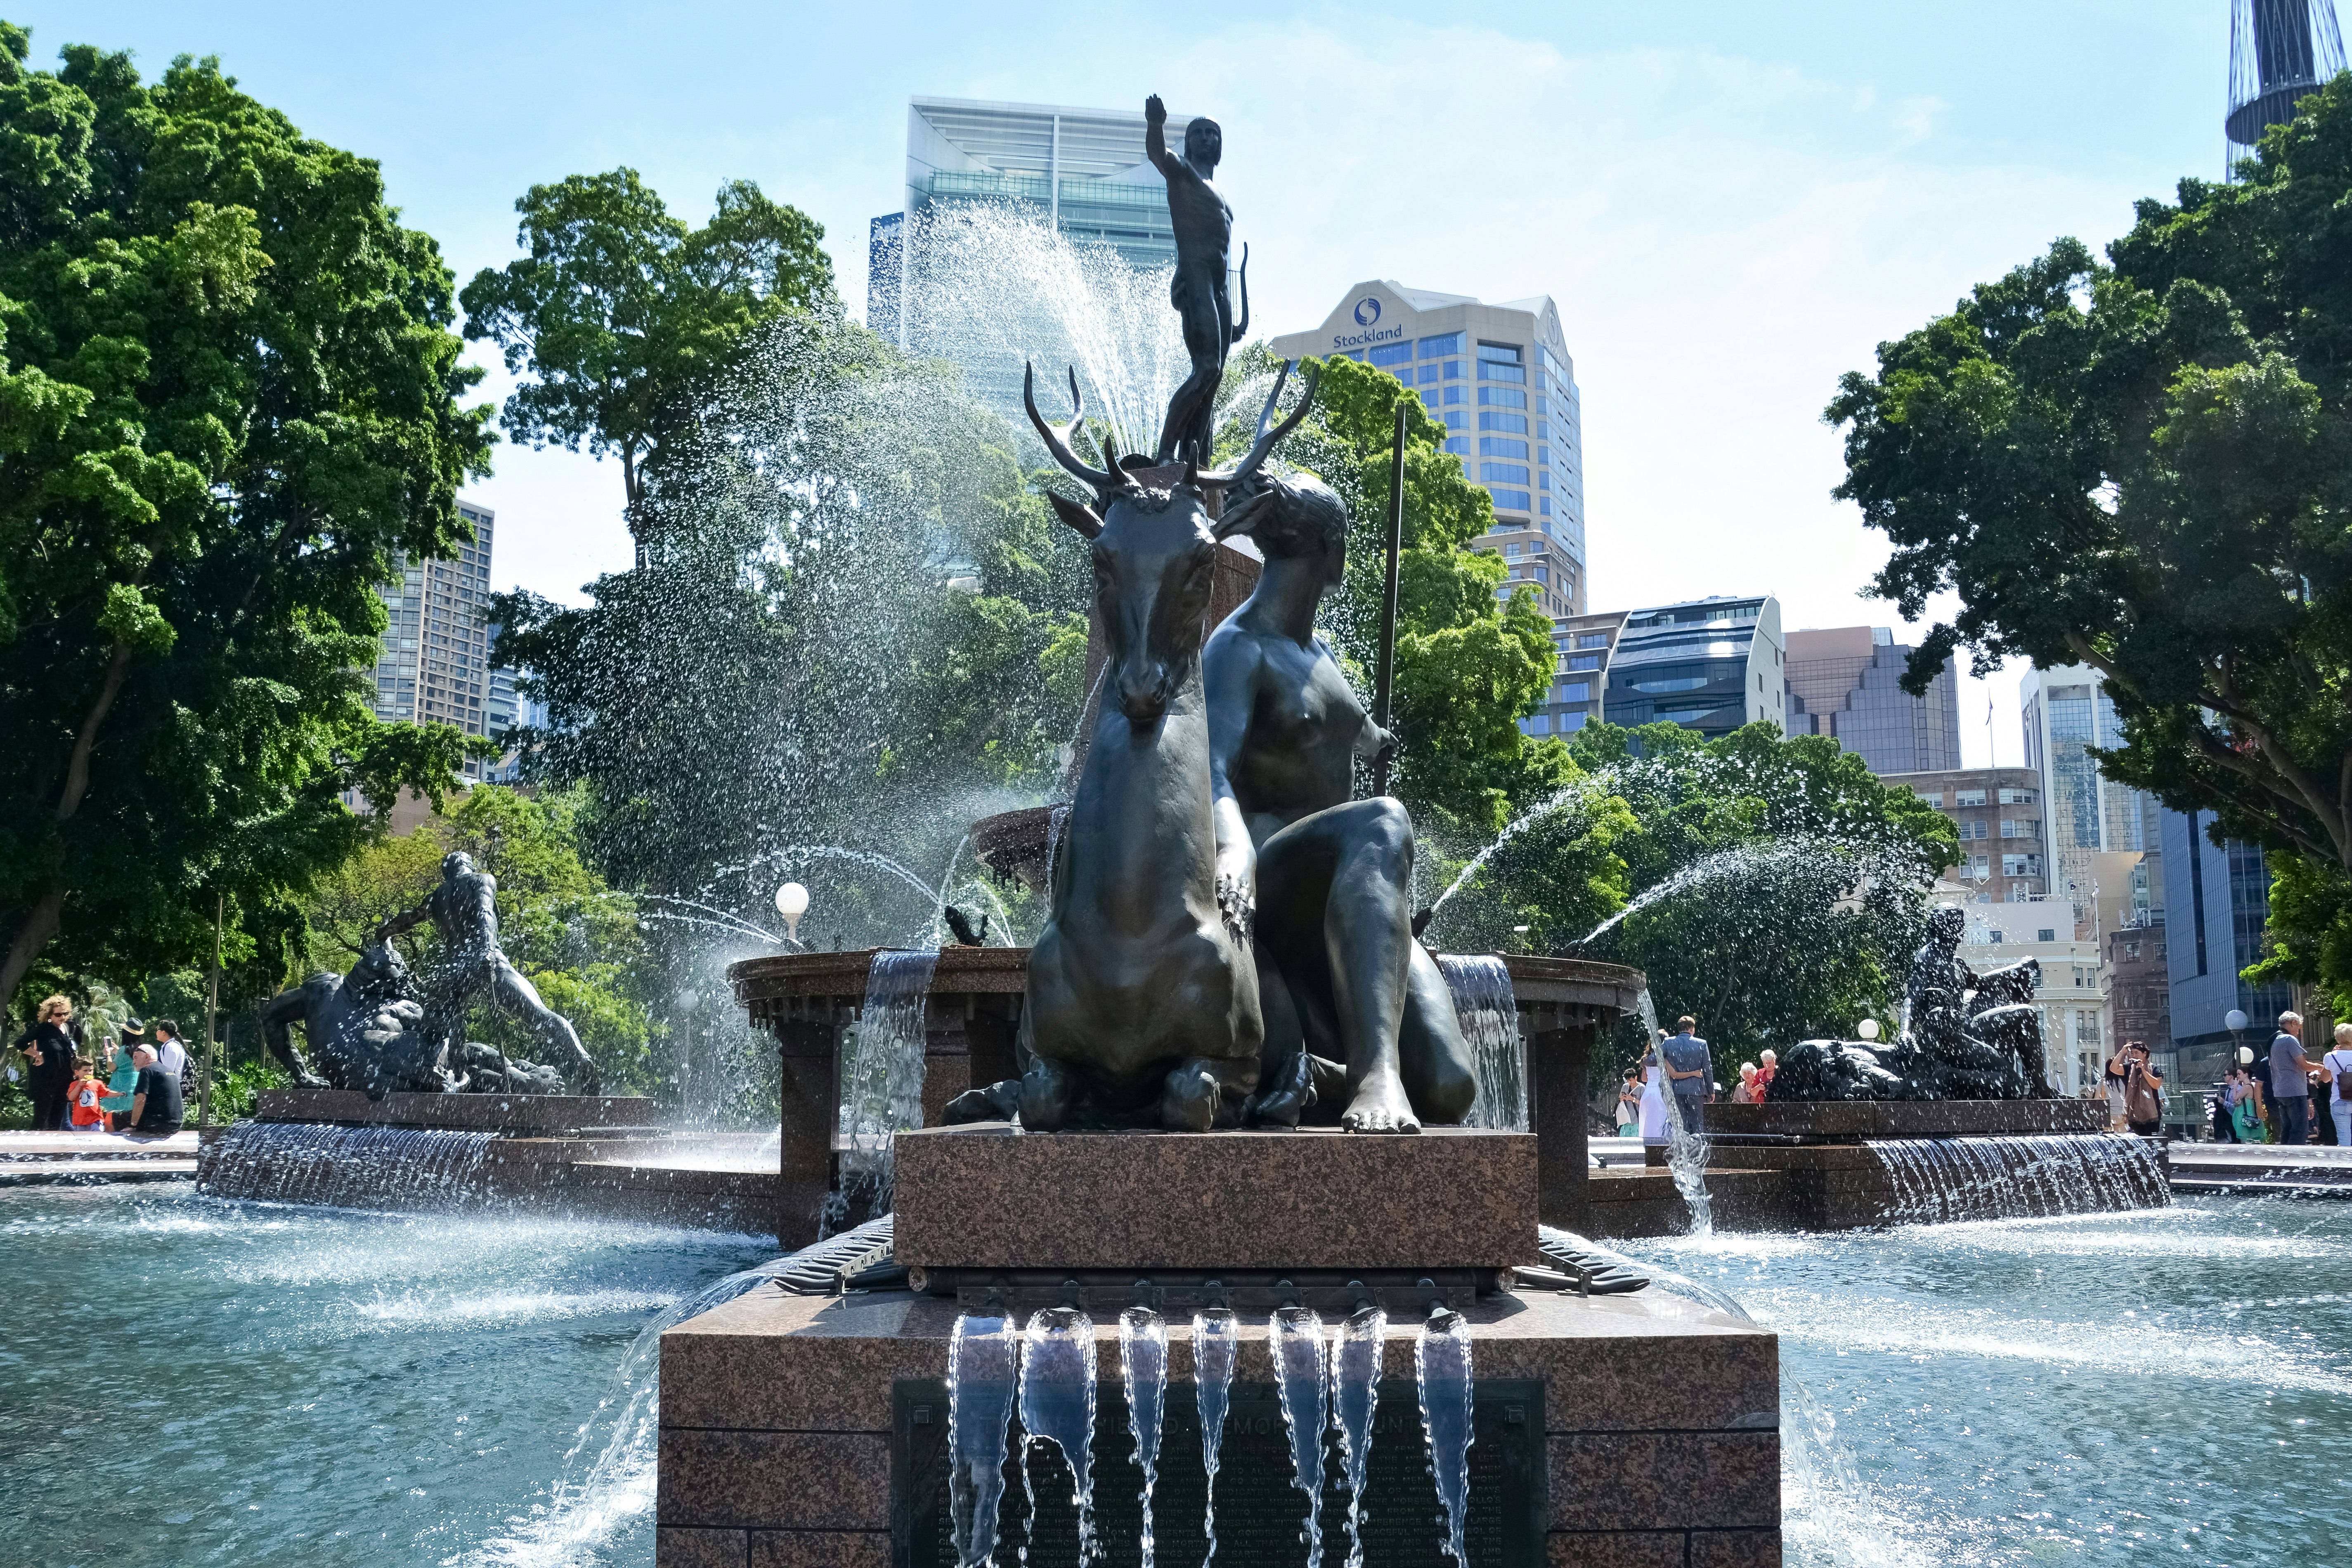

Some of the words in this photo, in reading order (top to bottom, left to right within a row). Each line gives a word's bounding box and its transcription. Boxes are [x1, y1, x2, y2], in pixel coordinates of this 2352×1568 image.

[1334, 324, 1402, 348] Stockland
[1394, 1497, 1432, 1505] HORSES
[1399, 1559, 1450, 1567] SACRIFICE
